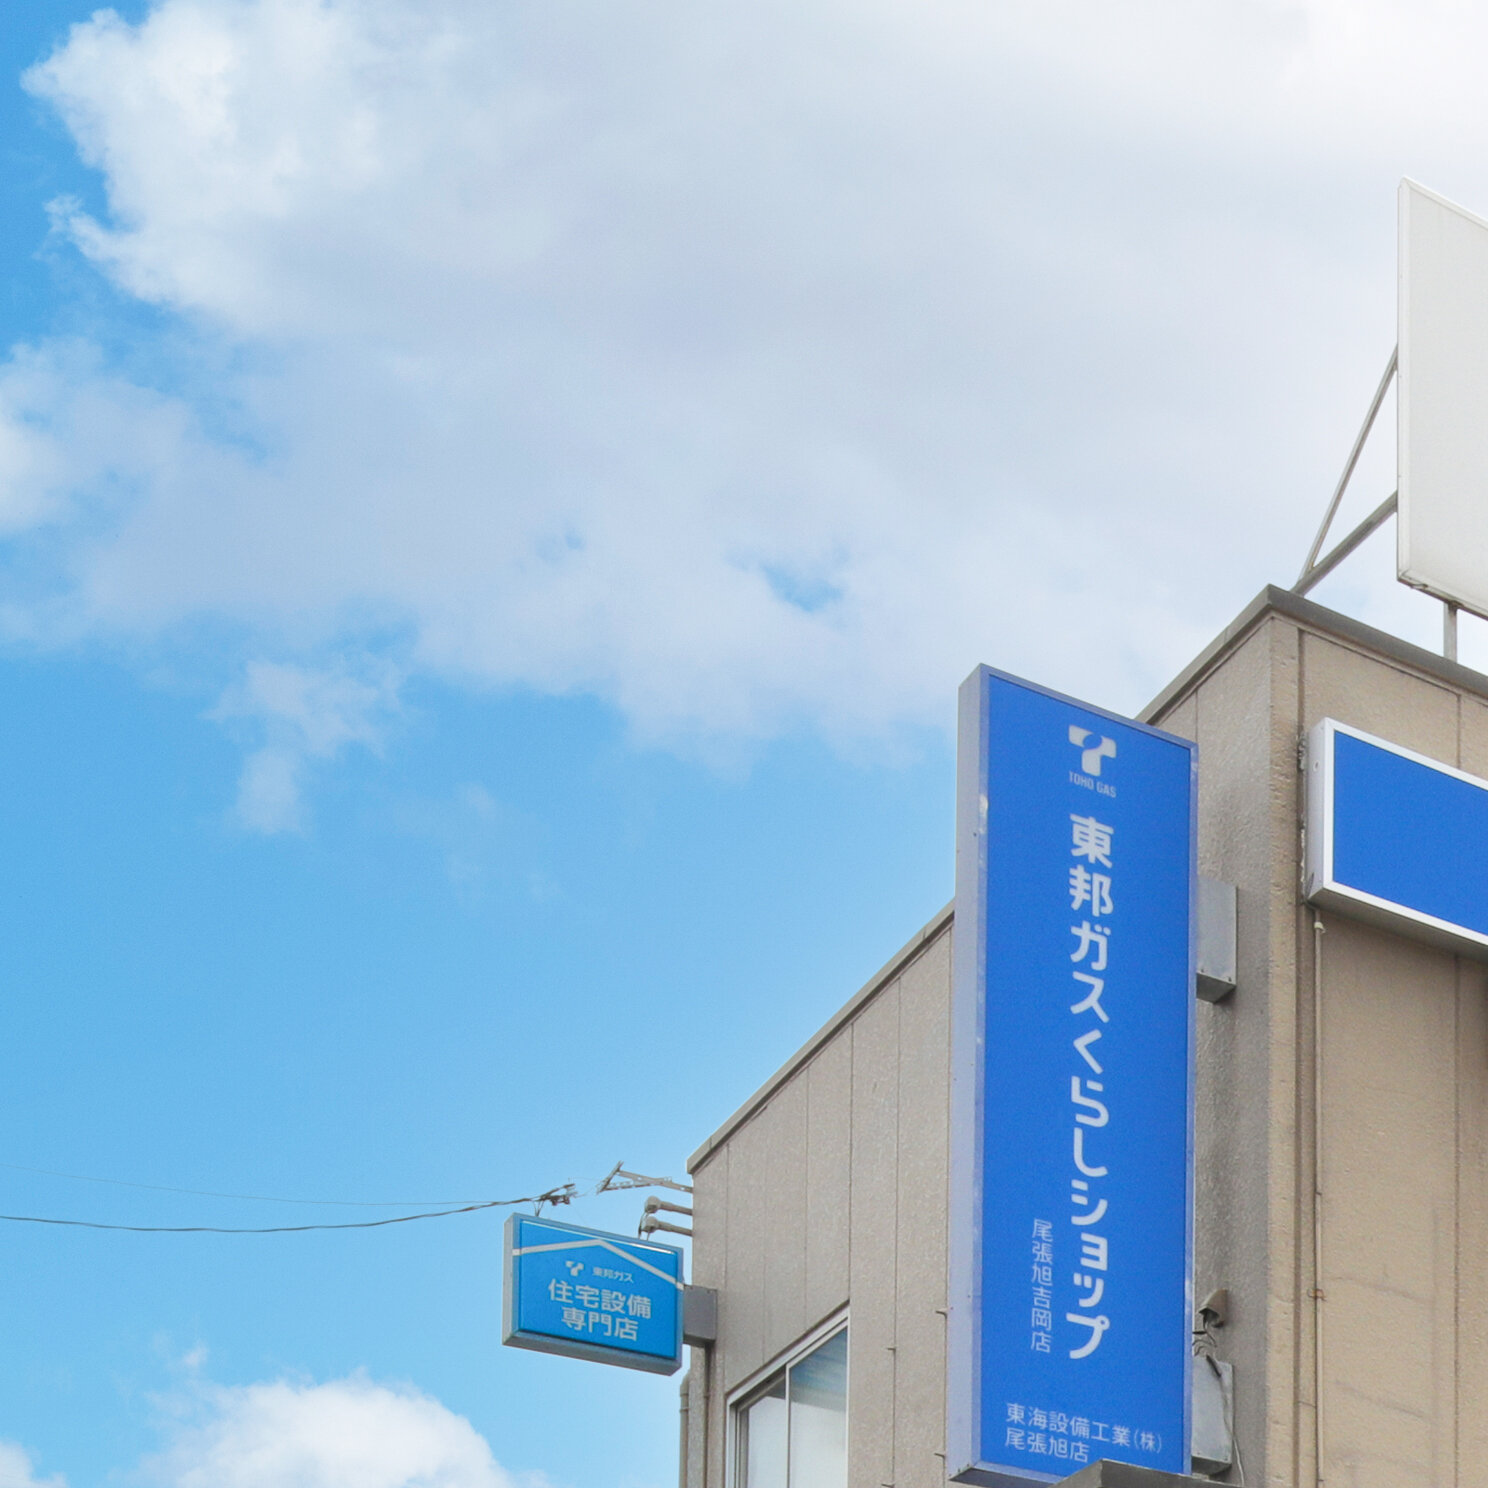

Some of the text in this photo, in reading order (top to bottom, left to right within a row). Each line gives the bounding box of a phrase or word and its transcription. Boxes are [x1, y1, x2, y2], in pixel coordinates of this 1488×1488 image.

[1068, 771, 1117, 799] TOHO GAS
[1066, 812, 1115, 1360] 東邦ガスくらしショップ
[592, 1265, 635, 1284] 東邦ガス
[1030, 1218, 1054, 1354] 尾張旭吉岡店
[547, 1278, 652, 1319] 住宅設備
[561, 1306, 640, 1342] 専門店
[1004, 1402, 1163, 1454] 東海設備工業(株)
[1004, 1426, 1090, 1464] 尾張旭店
